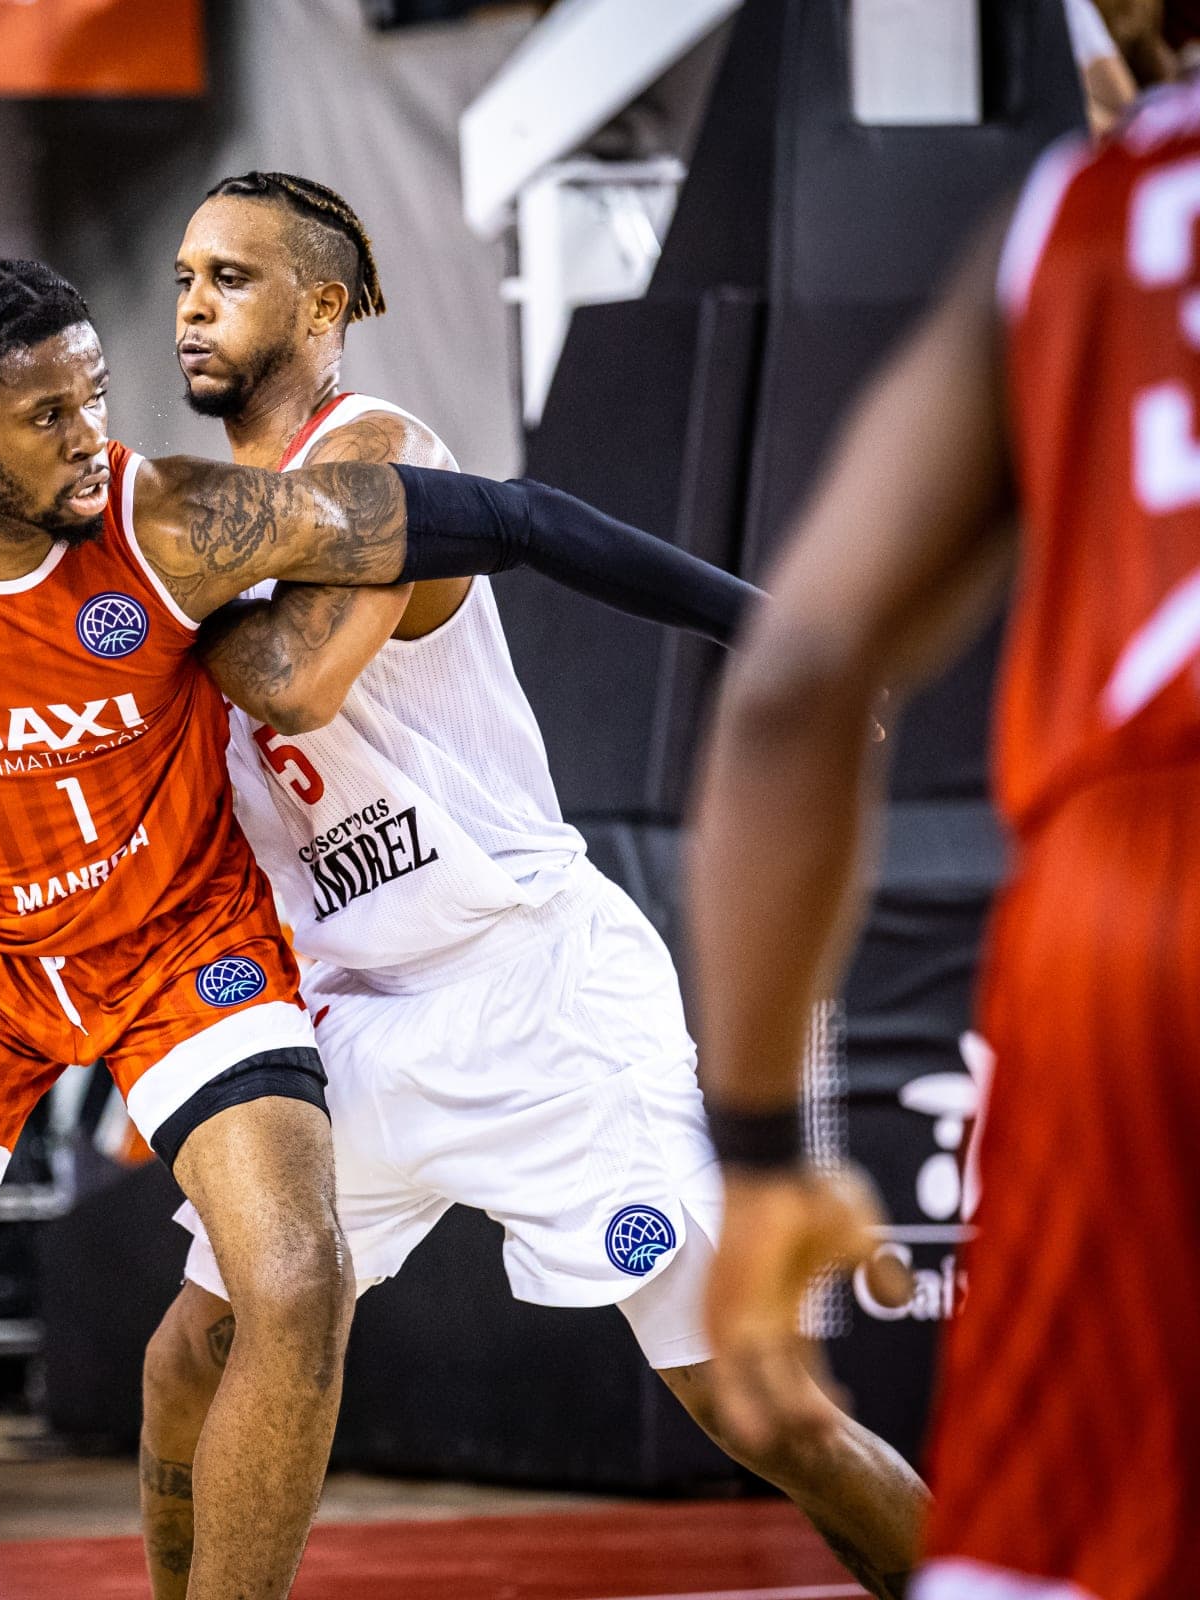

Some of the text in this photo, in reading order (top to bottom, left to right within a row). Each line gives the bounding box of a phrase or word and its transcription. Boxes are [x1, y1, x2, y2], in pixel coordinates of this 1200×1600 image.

[55, 776, 99, 845] 1
[298, 798, 390, 864] cservas
[12, 823, 150, 916] MANRA
[309, 806, 439, 922] MIREZ
